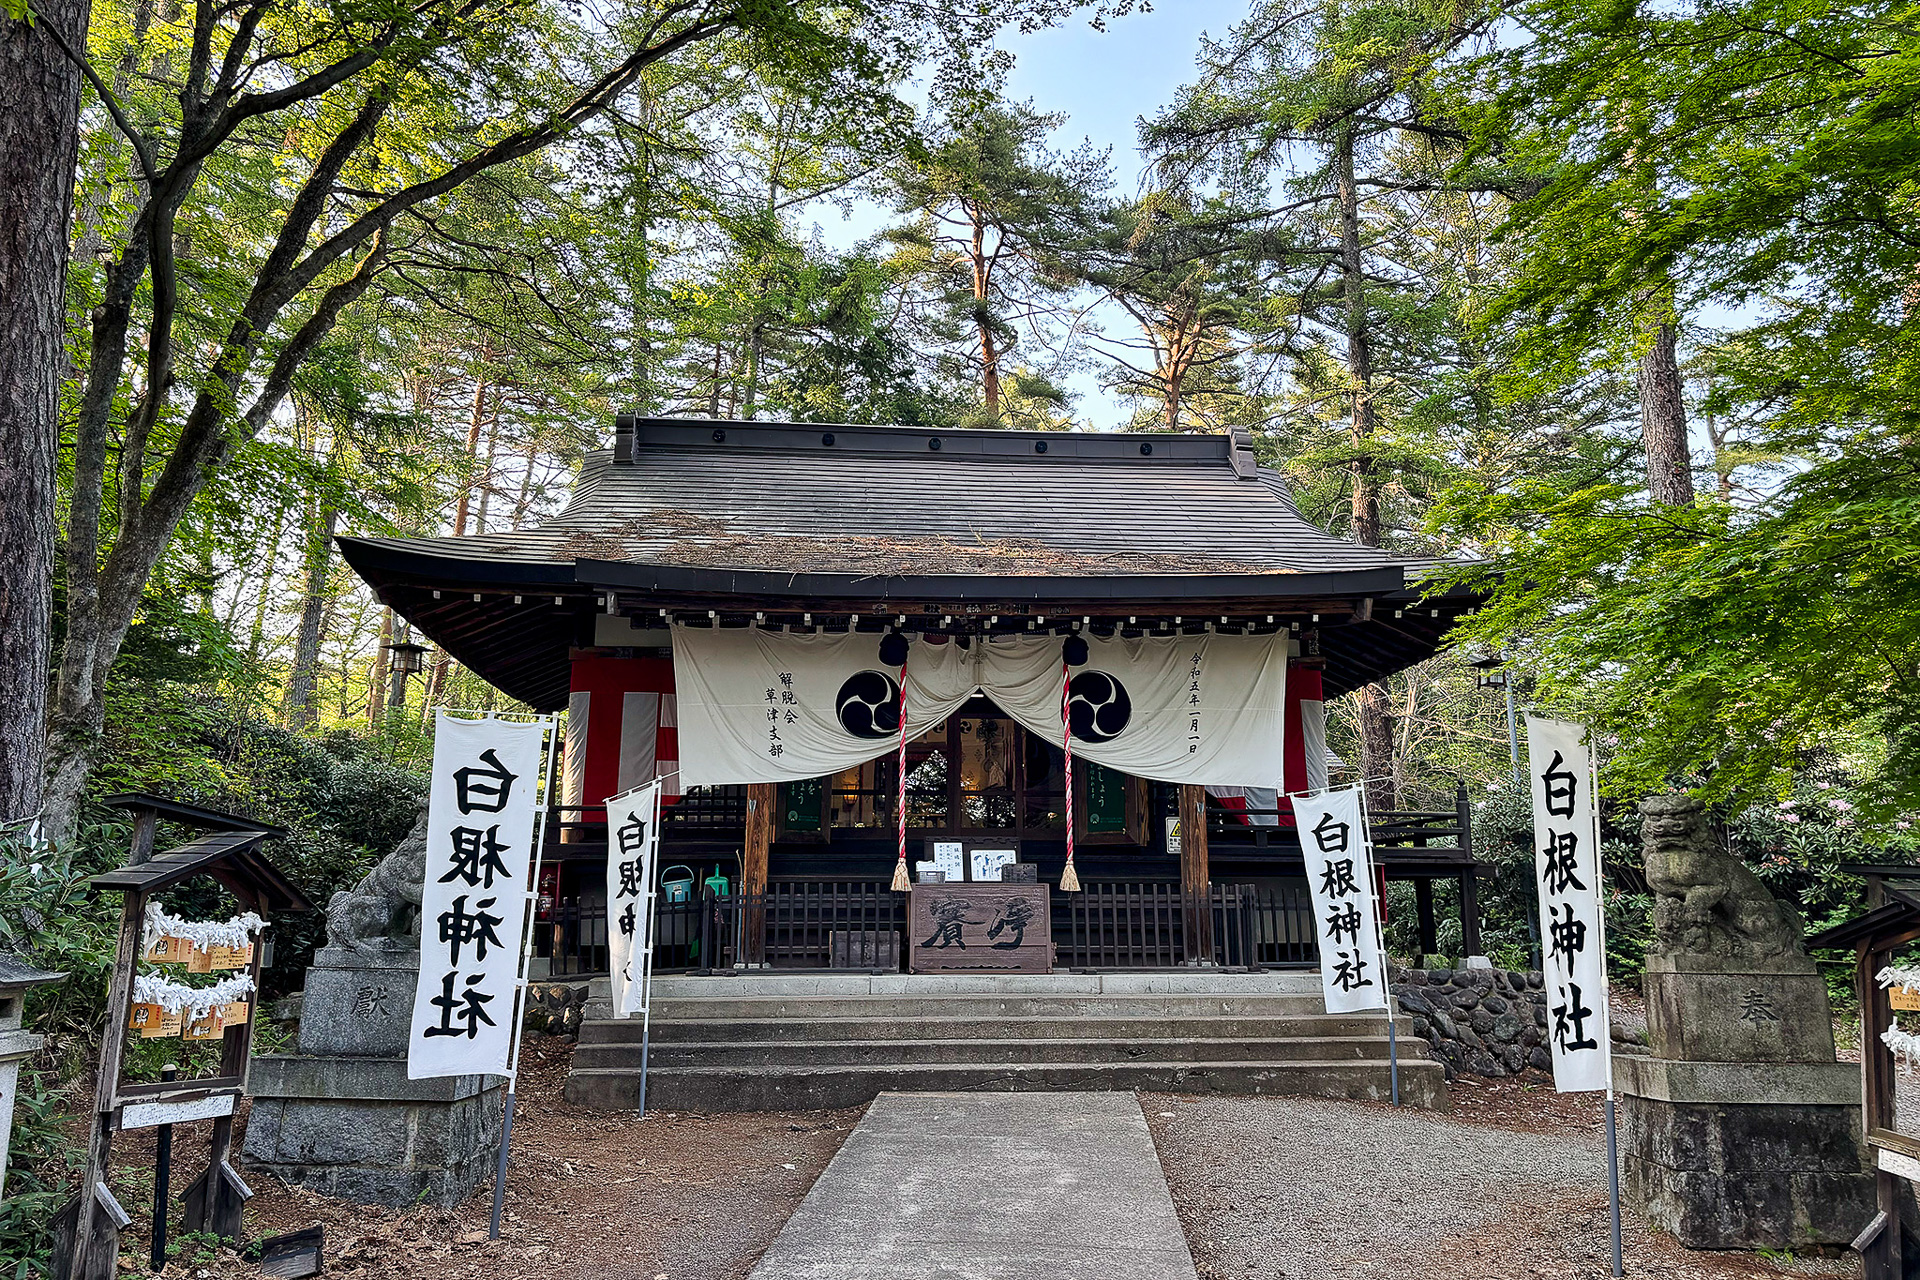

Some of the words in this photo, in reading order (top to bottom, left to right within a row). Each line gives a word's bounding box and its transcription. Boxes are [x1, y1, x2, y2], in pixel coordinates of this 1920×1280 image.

[765, 687, 784, 759] 草津支部
[779, 671, 799, 725] 解脱会
[1188, 652, 1202, 754] 令和五年一月一日
[1311, 812, 1373, 993] 白根神社
[1541, 749, 1598, 1056] 白根神社
[1740, 989, 1780, 1032] 奉
